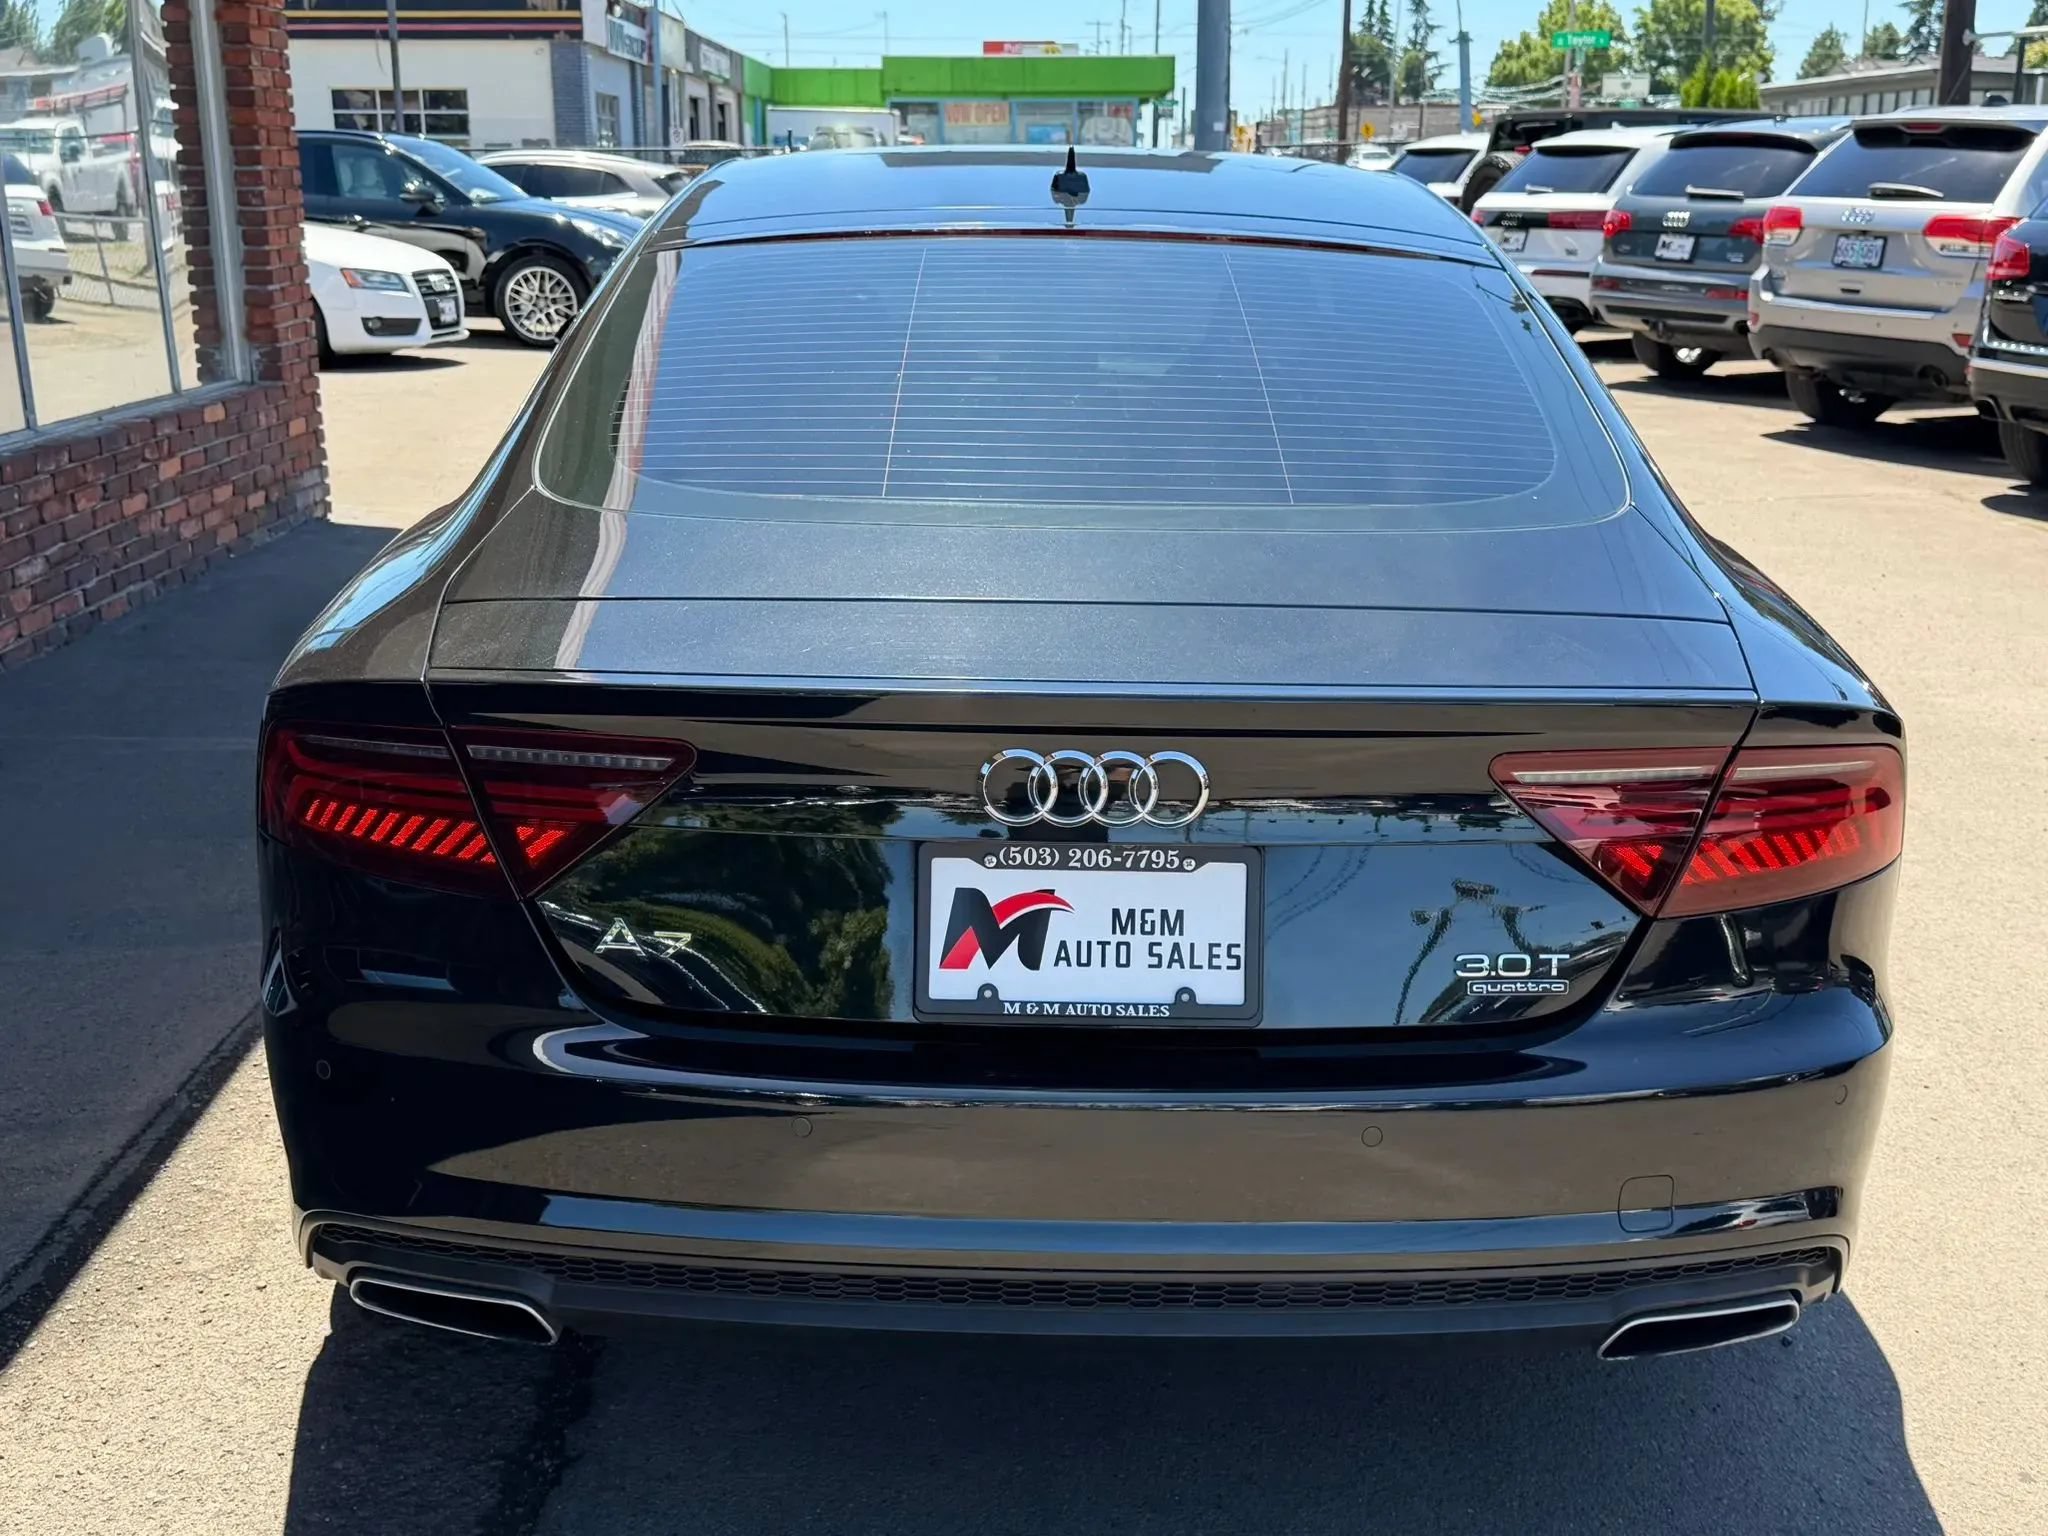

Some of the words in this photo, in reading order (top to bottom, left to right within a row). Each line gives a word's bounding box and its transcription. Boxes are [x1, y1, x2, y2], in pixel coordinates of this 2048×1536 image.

[998, 846, 1059, 868] (503)
[1068, 847, 1180, 869] 206-7795
[1111, 908, 1184, 936] M&M
[593, 917, 692, 958] A7
[1053, 940, 1132, 968] AUTO
[1147, 941, 1242, 970] SALES
[1472, 981, 1565, 995] quattro
[1003, 1002, 1021, 1015] M
[1026, 1003, 1039, 1015] &
[1043, 1003, 1060, 1016] M
[1066, 1003, 1111, 1017] AUTO
[1115, 1004, 1170, 1018] SALES
